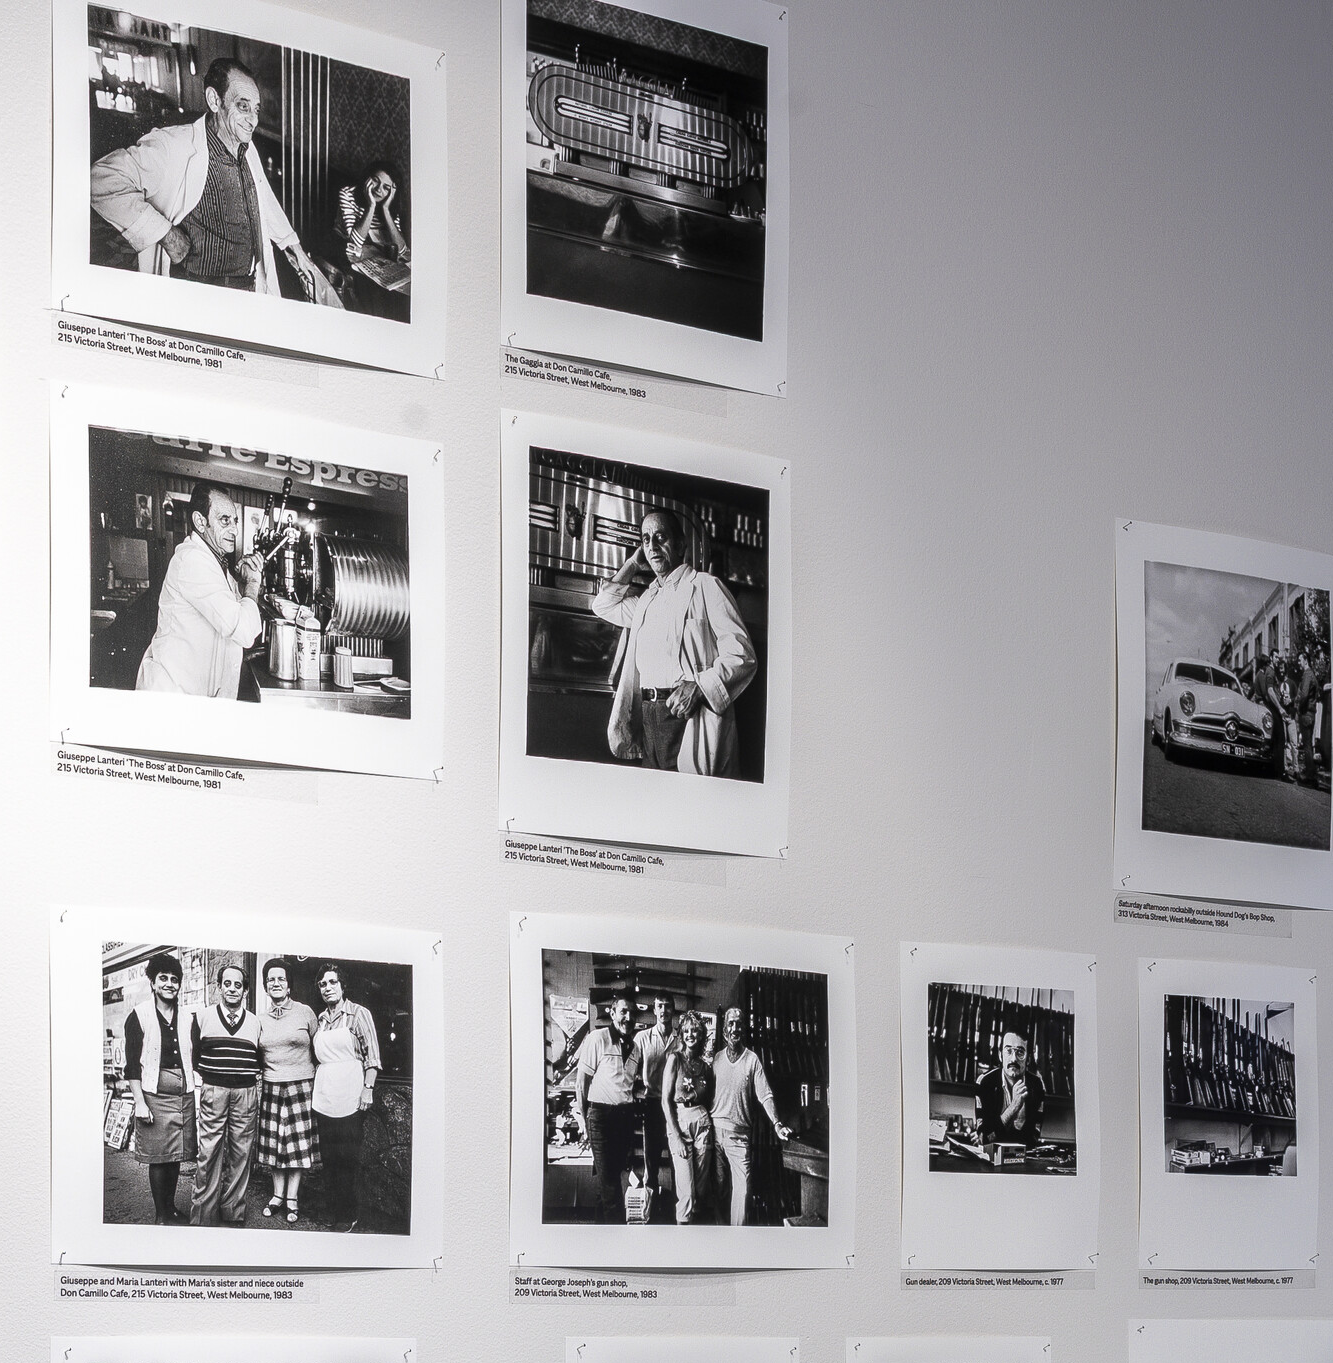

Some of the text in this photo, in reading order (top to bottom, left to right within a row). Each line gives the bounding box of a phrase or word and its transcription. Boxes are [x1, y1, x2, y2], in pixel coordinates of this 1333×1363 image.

[504, 353, 612, 382] The Gaggia at Don Camillo Cafe,
[504, 364, 647, 399] 215 Victoria Street, West Melbourne, 1983
[60, 1275, 99, 1287] Giuseppe
[99, 1276, 115, 1286] and
[116, 1277, 140, 1286] Maria
[140, 1277, 168, 1287] Lanteri
[168, 1278, 187, 1287] with
[216, 1278, 238, 1288] sister
[238, 1279, 254, 1288] and
[254, 1278, 275, 1288] niece
[275, 1279, 304, 1288] outside
[60, 1288, 293, 1301] Don Camillo Cafe, 215 Victoria Street, West Melbourne, 1983
[514, 1287, 530, 1297] 209
[530, 1288, 558, 1297] Victoria
[582, 1289, 601, 1298] West
[639, 1289, 658, 1299] 1983
